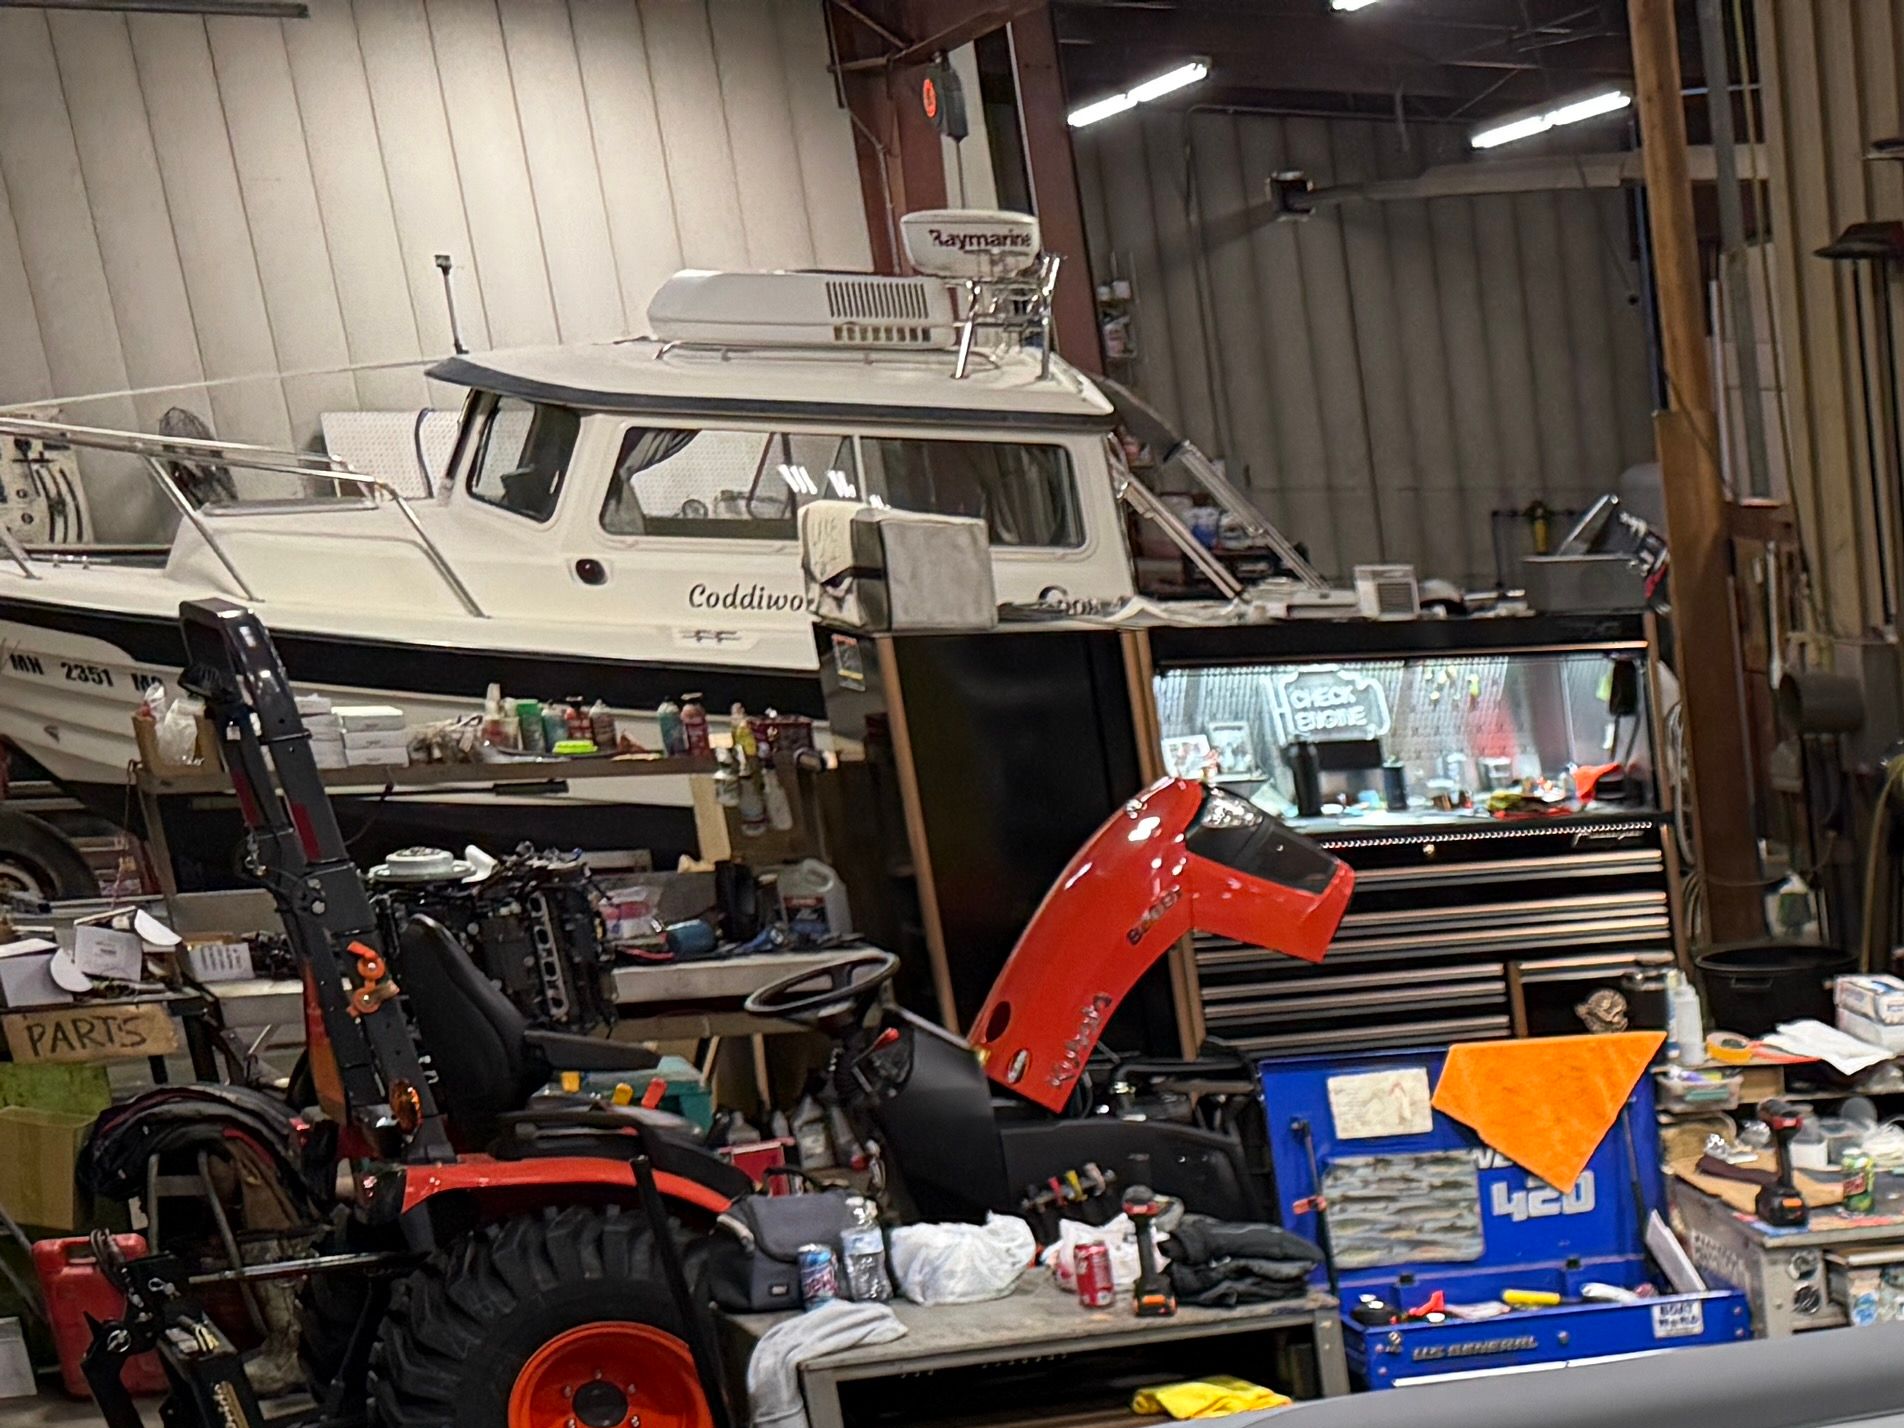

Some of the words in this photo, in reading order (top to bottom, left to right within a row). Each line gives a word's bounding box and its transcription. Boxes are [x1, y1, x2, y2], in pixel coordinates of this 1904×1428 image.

[928, 228, 1032, 249] Raymarine
[688, 582, 814, 612] Coddiwo
[60, 661, 114, 687] 2351
[1290, 684, 1358, 710] CHECK
[1294, 704, 1368, 732] ENGINE
[26, 1015, 147, 1057] PARTS
